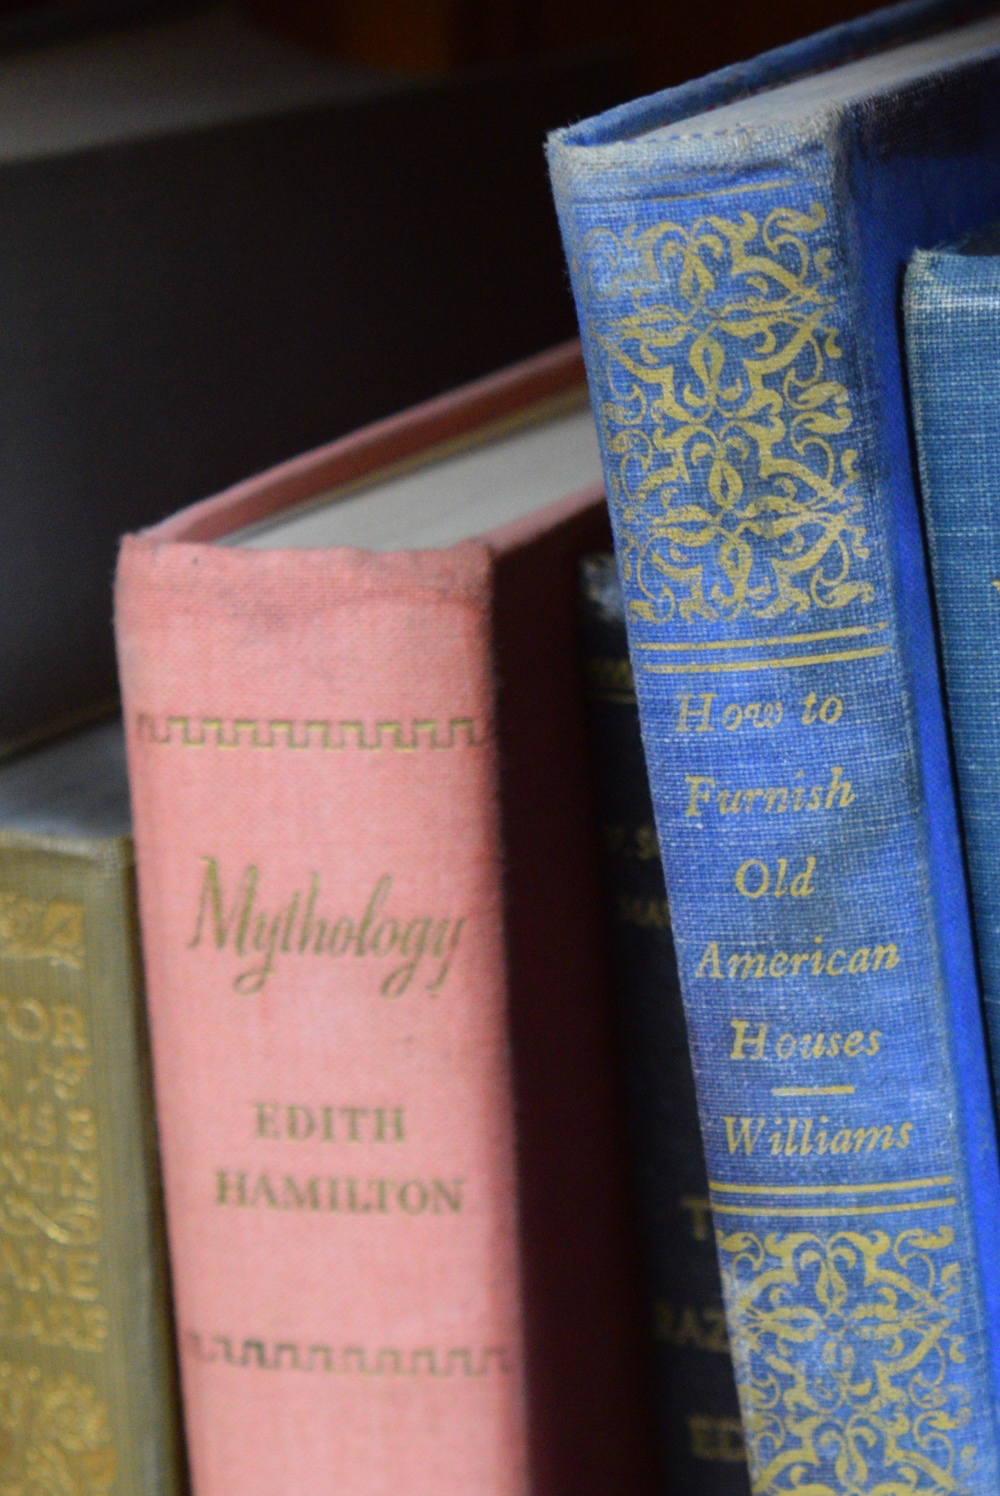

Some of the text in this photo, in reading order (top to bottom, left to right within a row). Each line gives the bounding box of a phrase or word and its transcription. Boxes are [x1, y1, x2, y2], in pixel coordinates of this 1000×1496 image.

[675, 691, 845, 733] How to
[684, 766, 857, 818] Furnish
[734, 856, 816, 899] Old
[185, 856, 468, 998] Mythology
[694, 937, 901, 980] American
[729, 1019, 883, 1061] Houses
[254, 1101, 407, 1143] EDITH
[722, 1115, 914, 1157] Williams
[213, 1168, 466, 1216] HAMILTON
